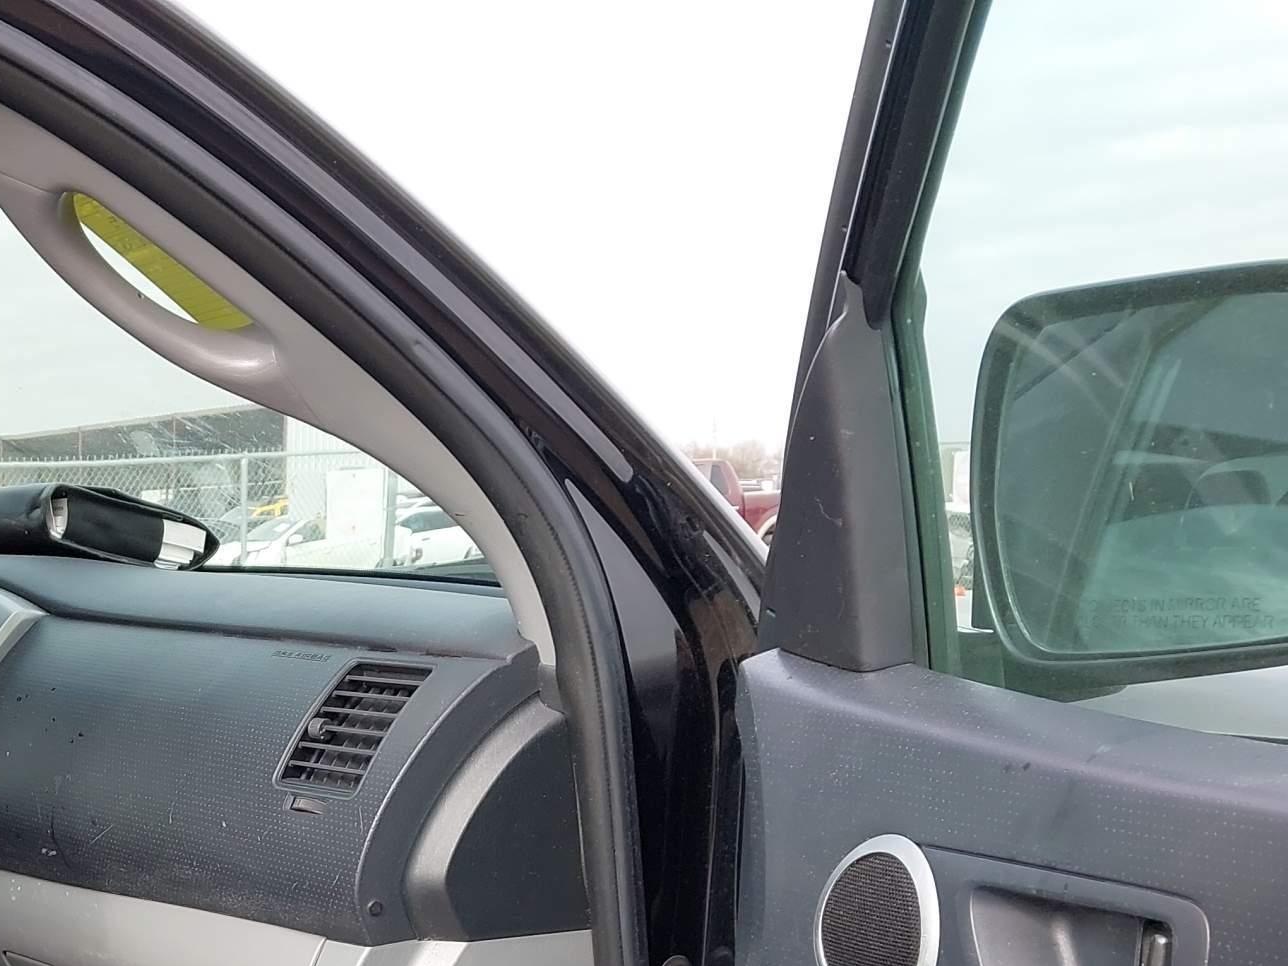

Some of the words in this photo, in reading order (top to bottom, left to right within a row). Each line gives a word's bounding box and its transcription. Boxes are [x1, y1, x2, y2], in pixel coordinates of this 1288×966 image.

[1088, 600, 1147, 613] OECTS
[1151, 599, 1165, 612] IN
[1231, 597, 1262, 612] ARE
[1172, 614, 1209, 630] THEY
[1213, 614, 1275, 629] APPEAR
